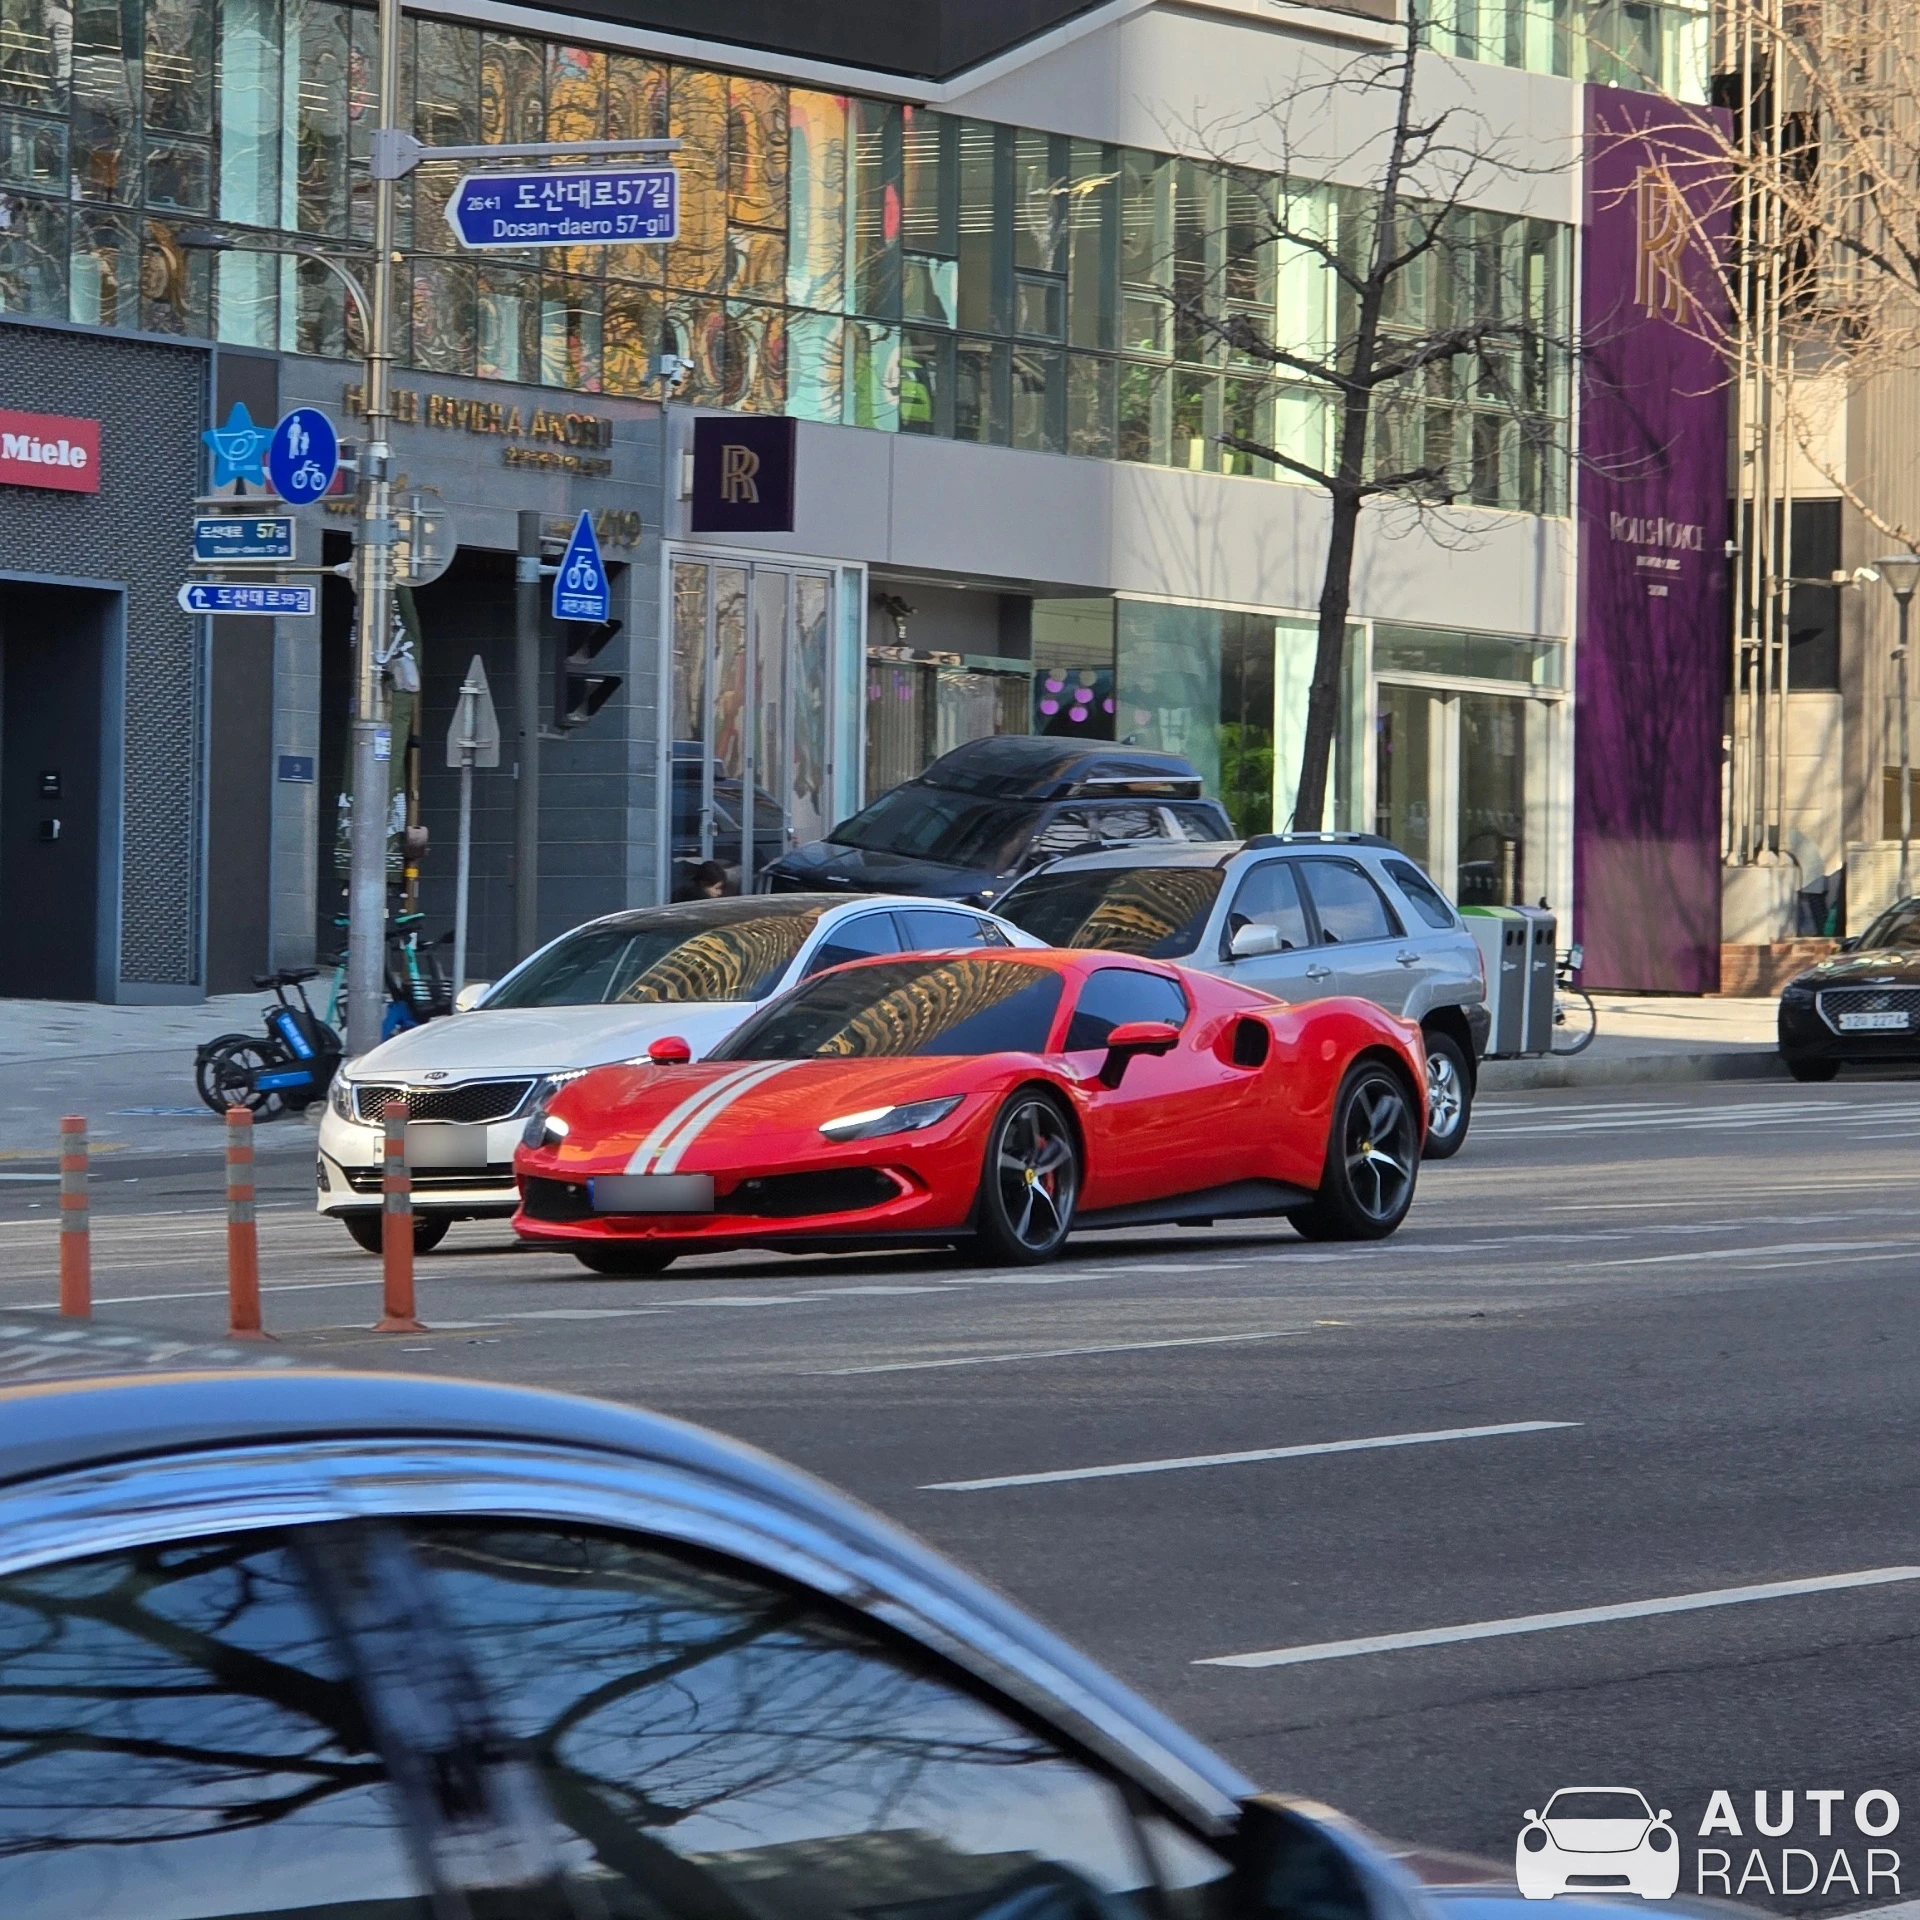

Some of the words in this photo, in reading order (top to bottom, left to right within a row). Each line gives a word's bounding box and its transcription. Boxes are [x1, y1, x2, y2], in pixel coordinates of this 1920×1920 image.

[514, 177, 670, 212] 도산대로57길
[493, 218, 612, 238] Dosan-daero
[616, 213, 670, 236] 57-gil
[1, 433, 87, 468] Miele
